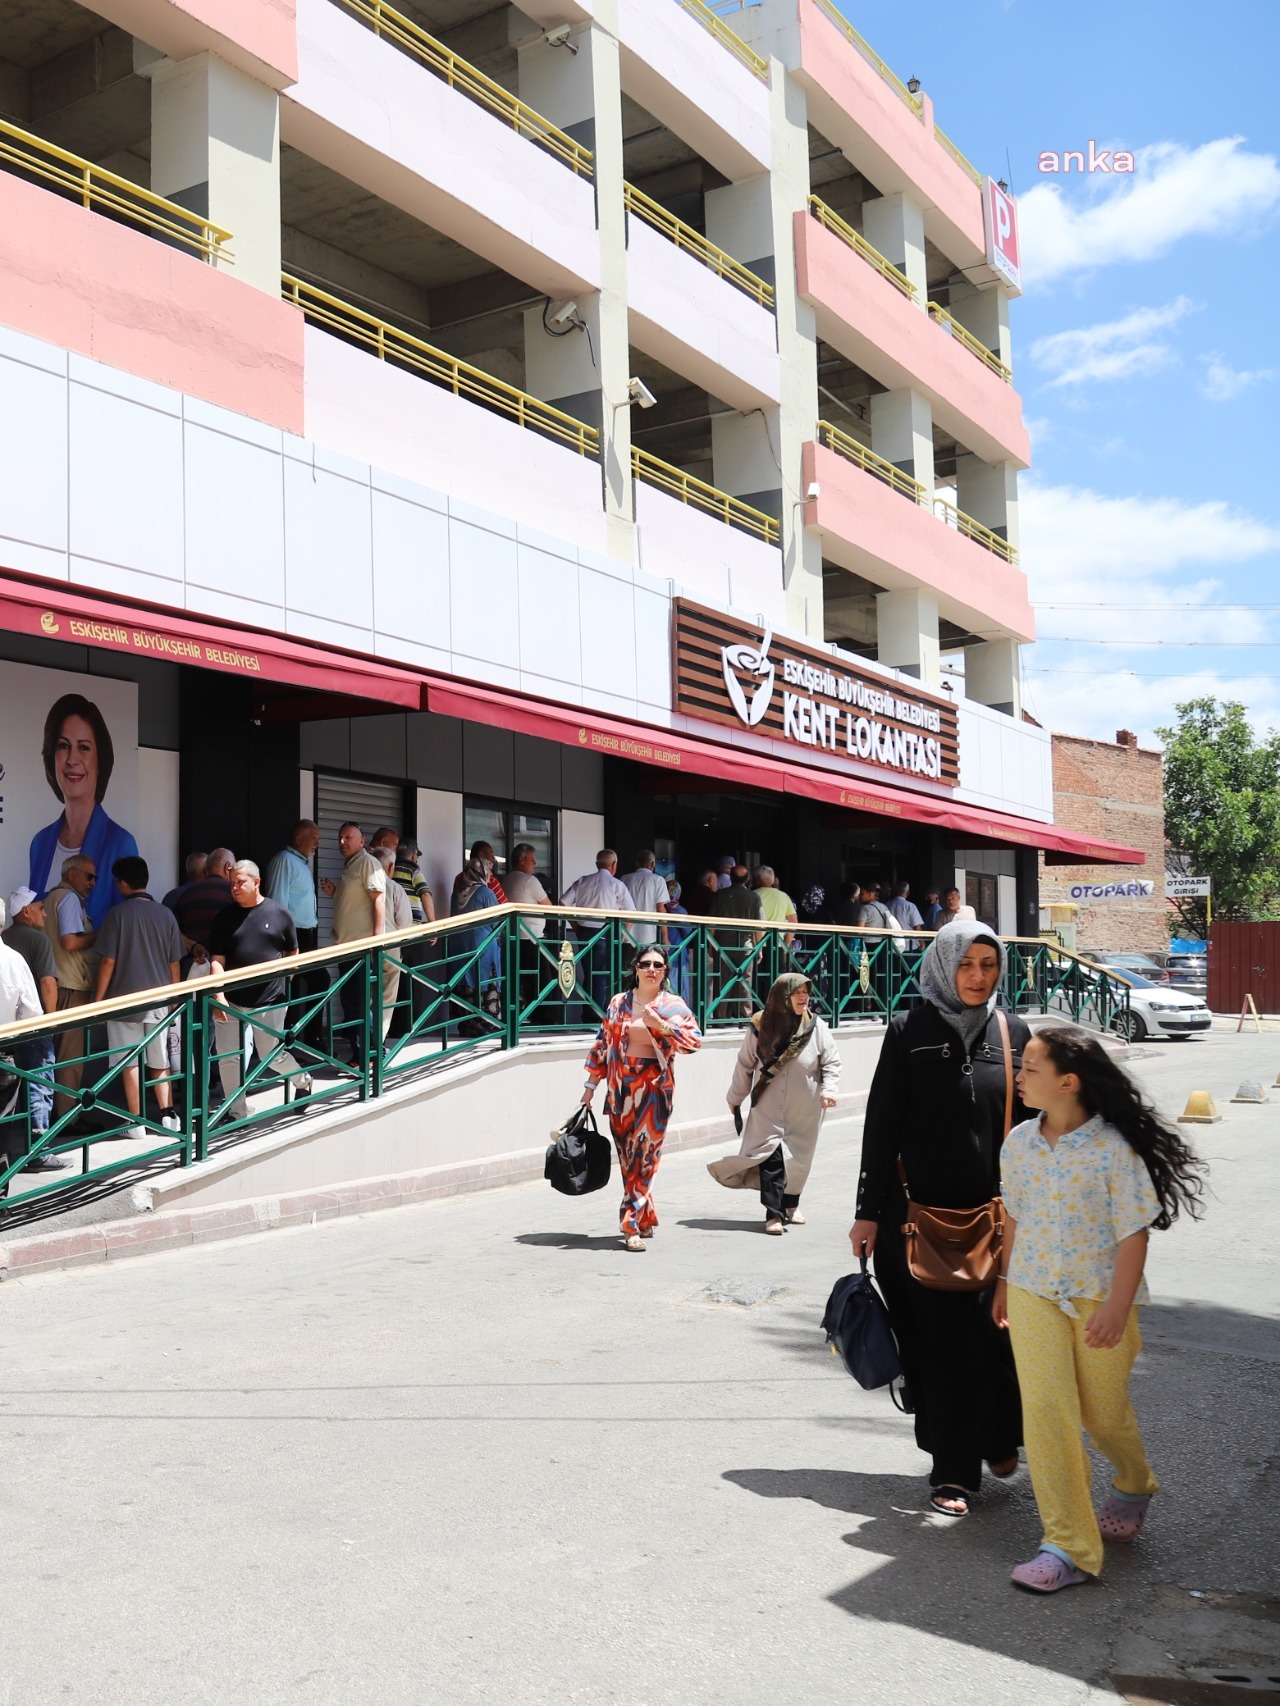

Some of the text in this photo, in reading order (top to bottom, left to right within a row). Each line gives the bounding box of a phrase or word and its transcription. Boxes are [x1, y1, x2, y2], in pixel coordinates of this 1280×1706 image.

[994, 189, 1011, 251] P
[69, 620, 261, 672] ESKİŞEHİR BÜYÜKŞEHİR BELEDİYESİ
[783, 657, 941, 733] ESKİŞEHİR BÜYÜKŞEHİR BELEDİYESİ
[591, 733, 681, 766] ESKİŞEHİR BÜYÜKŞEHİR BELEDİYESİ
[783, 690, 942, 779] KENT LOKANTASI
[1070, 883, 1150, 899] OTOPARK
[1166, 879, 1208, 887] OTOPARK
